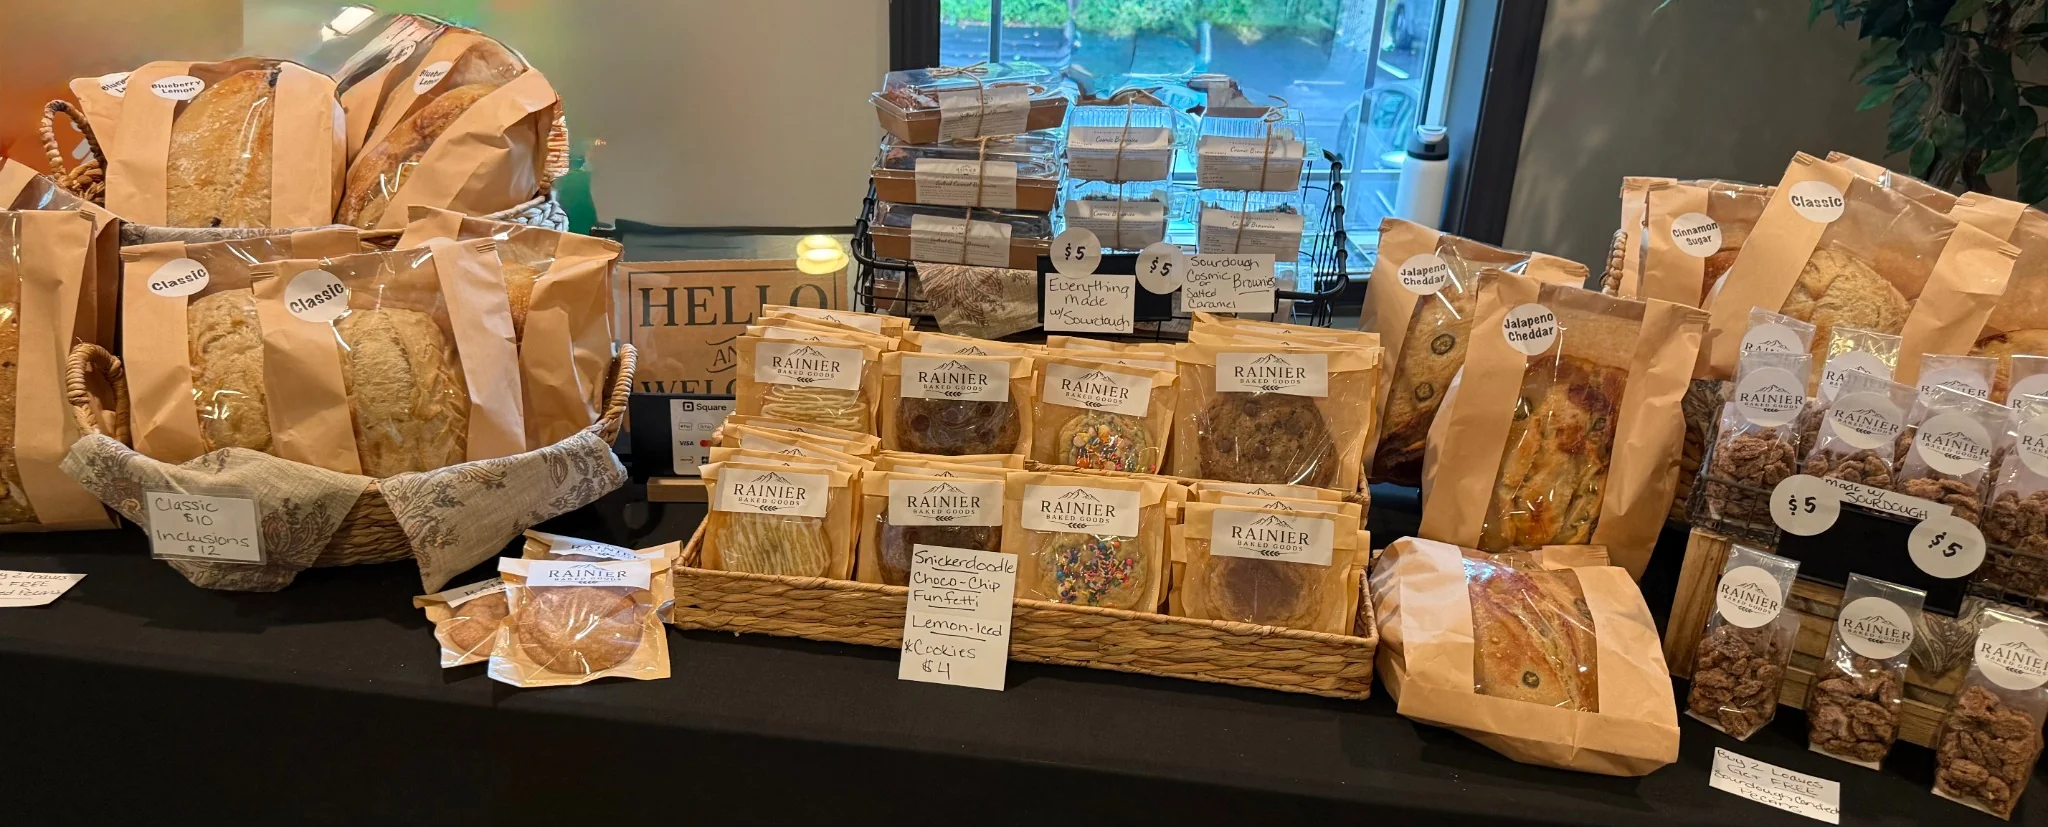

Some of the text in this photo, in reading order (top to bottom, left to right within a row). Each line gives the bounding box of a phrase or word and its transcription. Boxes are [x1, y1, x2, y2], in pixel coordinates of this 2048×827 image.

[151, 80, 201, 89] Blueberry
[1250, 147, 1274, 155] Browes
[1791, 195, 1843, 208] Classic
[1231, 220, 1249, 228] Comic
[1672, 222, 1719, 238] Cinnamon
[1686, 235, 1712, 247] Sugar
[1065, 242, 1086, 260] $5
[1150, 256, 1173, 277] $5
[1190, 256, 1260, 271] Sourdough
[1400, 263, 1446, 276] Jalapeno
[151, 267, 207, 291] Classic
[1186, 269, 1232, 283] Cosmic
[1403, 274, 1445, 286] Cheddar
[1049, 277, 1130, 299] Everything
[1186, 288, 1217, 299] Salted
[290, 282, 345, 314] Classic
[1188, 299, 1236, 309] Caramel
[1503, 312, 1554, 329] Jalapeno
[1508, 326, 1554, 342] Cheddar
[772, 356, 841, 373] RAINIER
[1234, 366, 1306, 379] RAINIER
[918, 371, 988, 385] RAINIER
[1061, 378, 1129, 399] RAINIER
[1740, 392, 1803, 405] RAINIER
[696, 403, 727, 412] Square
[1834, 409, 1899, 433] RAINIER
[1922, 432, 1990, 457] RAINIER
[733, 483, 806, 500] RAINIER
[155, 497, 219, 512] Classic
[907, 495, 981, 508] RAINIER
[1040, 499, 1116, 518] RAINIER
[1788, 494, 1816, 516] $5
[1845, 492, 1928, 520] SOURDOUGH
[183, 513, 214, 526] $10
[156, 529, 250, 548] Inclusions
[1231, 525, 1310, 546] RAINIER
[1928, 531, 1963, 557] $5
[914, 549, 1016, 574] Snickerdoodle
[549, 569, 627, 578] RAINIER
[913, 590, 979, 607] Funfetti
[1721, 583, 1778, 612] RAINIER
[912, 614, 1002, 637] Lemon-Iced
[1843, 618, 1911, 641] RAINIER
[1717, 749, 1746, 769] Buy
[1751, 762, 1764, 772] 2
[1714, 769, 1793, 801] Sourdough
[1771, 777, 1819, 796] FREE
